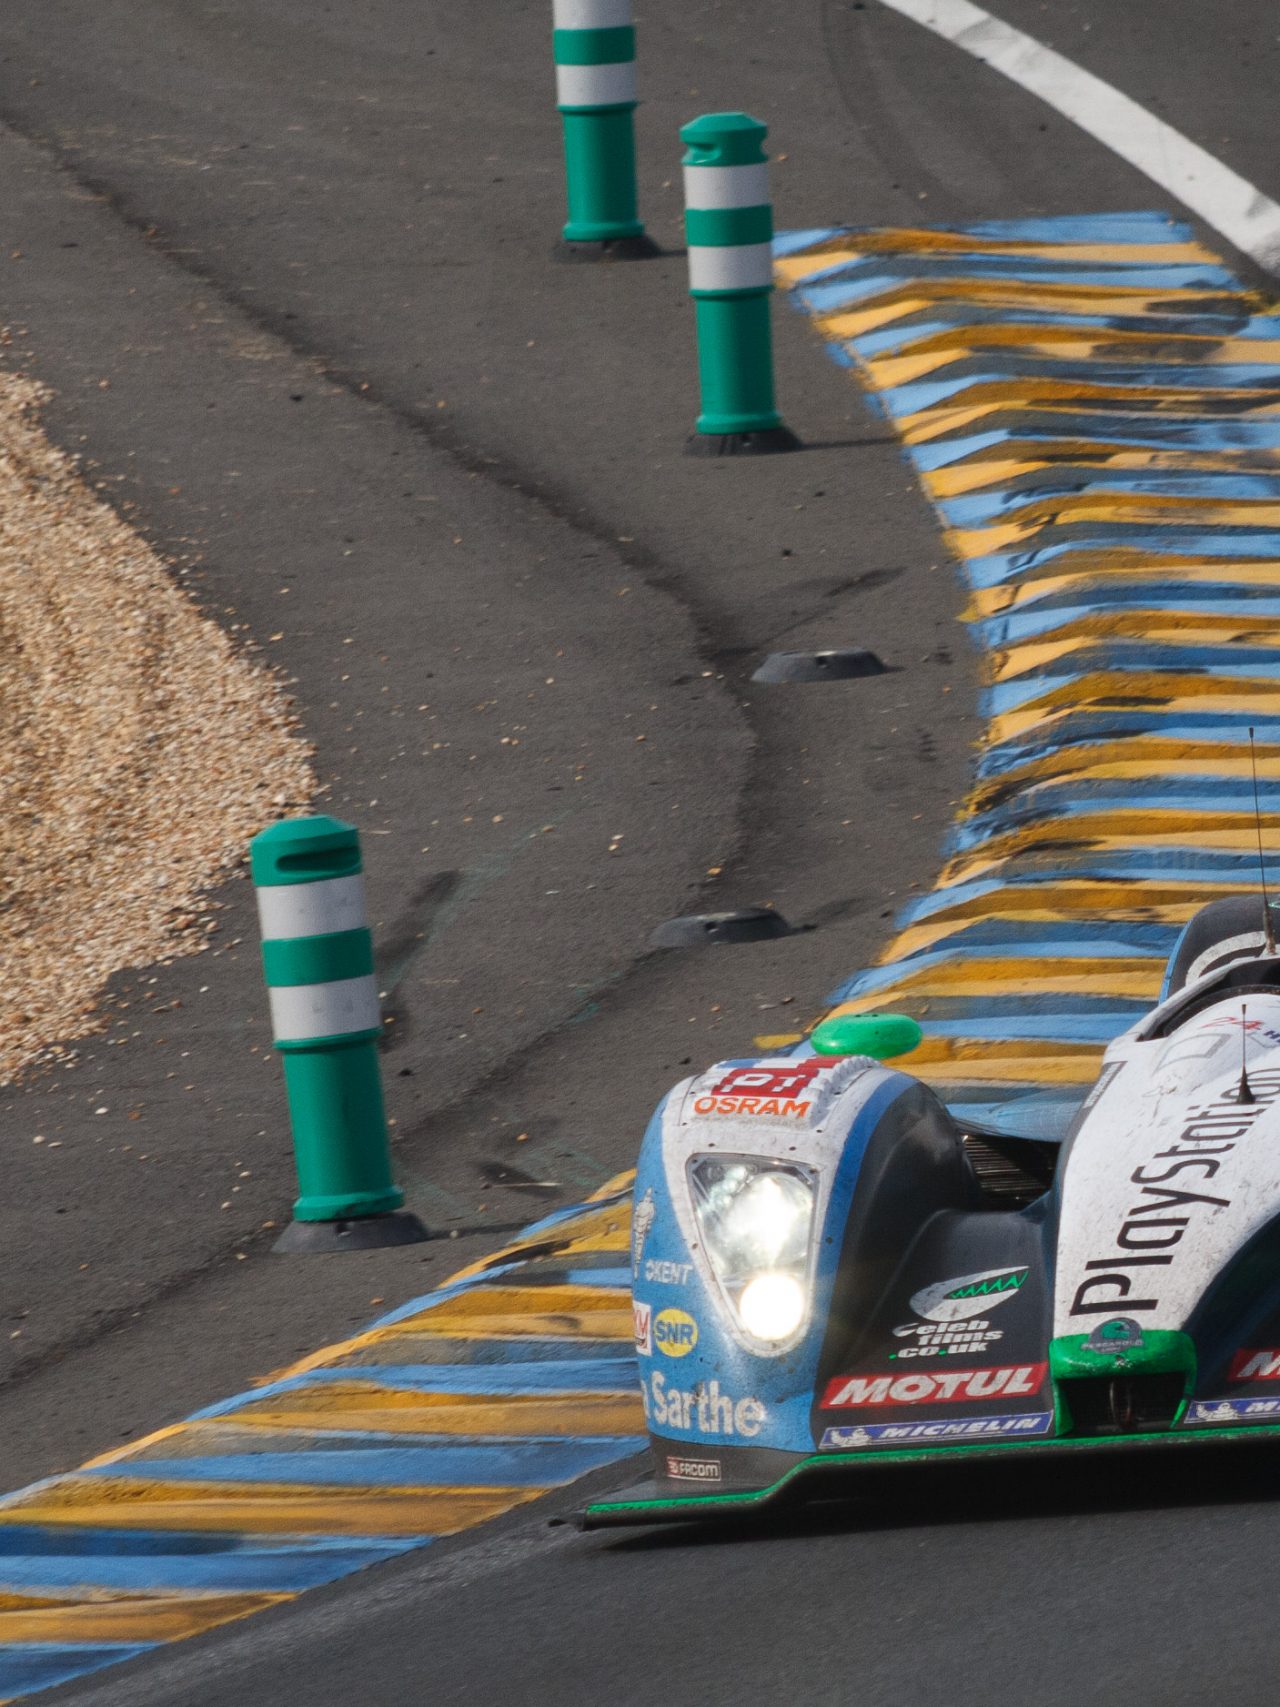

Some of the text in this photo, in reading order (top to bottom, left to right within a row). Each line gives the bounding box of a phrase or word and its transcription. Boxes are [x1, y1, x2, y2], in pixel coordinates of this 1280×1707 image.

[694, 1097, 811, 1118] OSRAM
[655, 1320, 694, 1346] SNR
[918, 1331, 1004, 1346] films
[888, 1342, 988, 1360] .co.uk
[828, 1367, 1034, 1406] MOTUL
[651, 1371, 764, 1438] Sarthe
[878, 1417, 1041, 1439] MICHELIN
